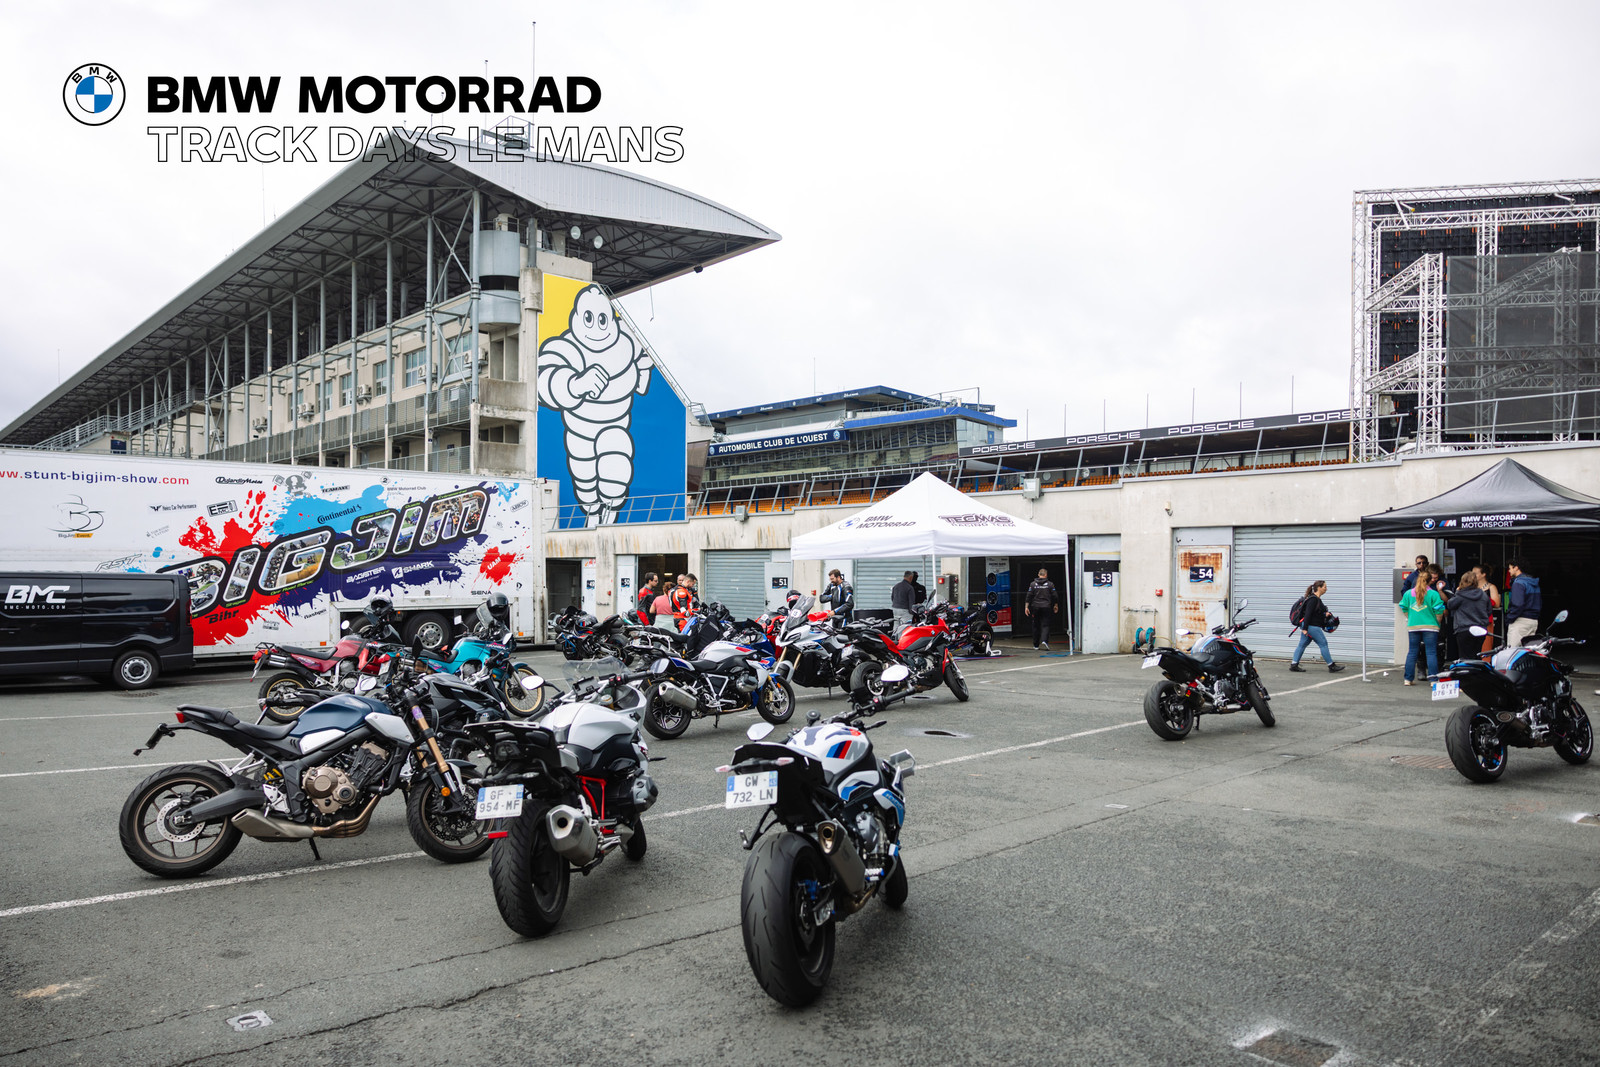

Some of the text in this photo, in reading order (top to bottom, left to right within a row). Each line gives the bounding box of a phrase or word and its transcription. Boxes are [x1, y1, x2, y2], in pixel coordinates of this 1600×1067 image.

[1168, 420, 1255, 436] PORSCHE
[719, 433, 828, 454] AUTOMOBILE CLUB DE L'OUEST
[1066, 431, 1141, 445] PORSCHE
[972, 441, 1036, 454] PORSCHE
[317, 505, 357, 524] Continental
[863, 515, 894, 523] BMW
[937, 513, 1013, 525] TECMAS
[1482, 514, 1527, 522] MOTORRAD
[856, 521, 917, 529] MOTORRAD
[1461, 520, 1514, 529] MOTORSPORT
[402, 560, 435, 573] SHARK
[1100, 573, 1112, 583] 53
[1198, 568, 1213, 579] 54
[778, 578, 788, 586] 51
[4, 585, 71, 604] BMC
[205, 609, 239, 624] Bihr
